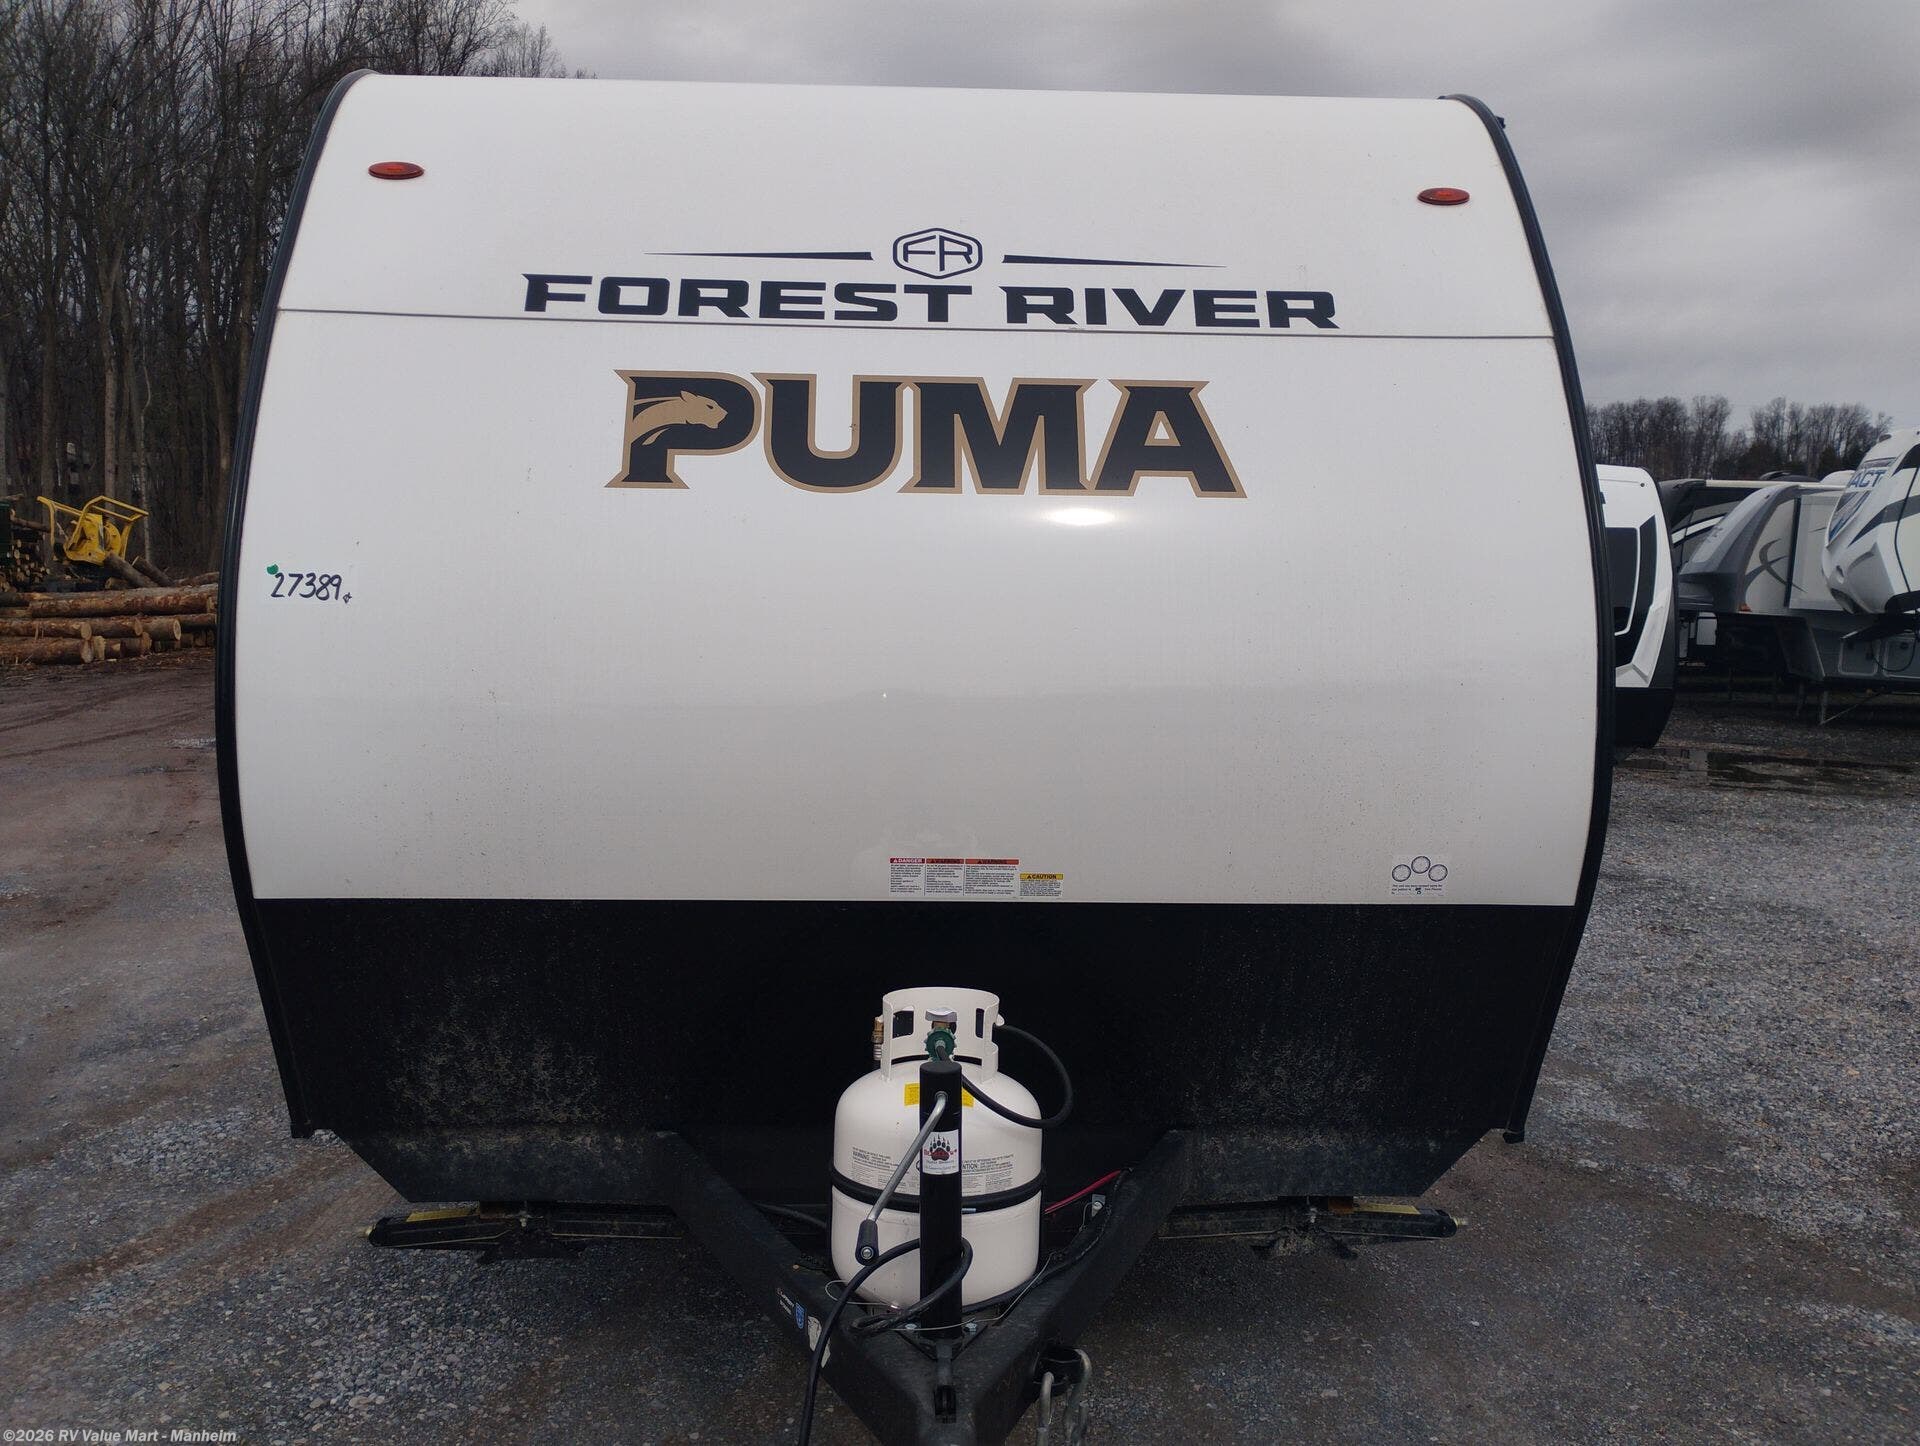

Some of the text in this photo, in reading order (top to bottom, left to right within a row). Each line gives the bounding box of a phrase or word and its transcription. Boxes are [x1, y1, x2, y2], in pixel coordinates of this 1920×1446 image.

[521, 272, 1341, 329] FOREST RIVER
[605, 369, 1248, 499] PUMA
[1848, 470, 1886, 488] ACT
